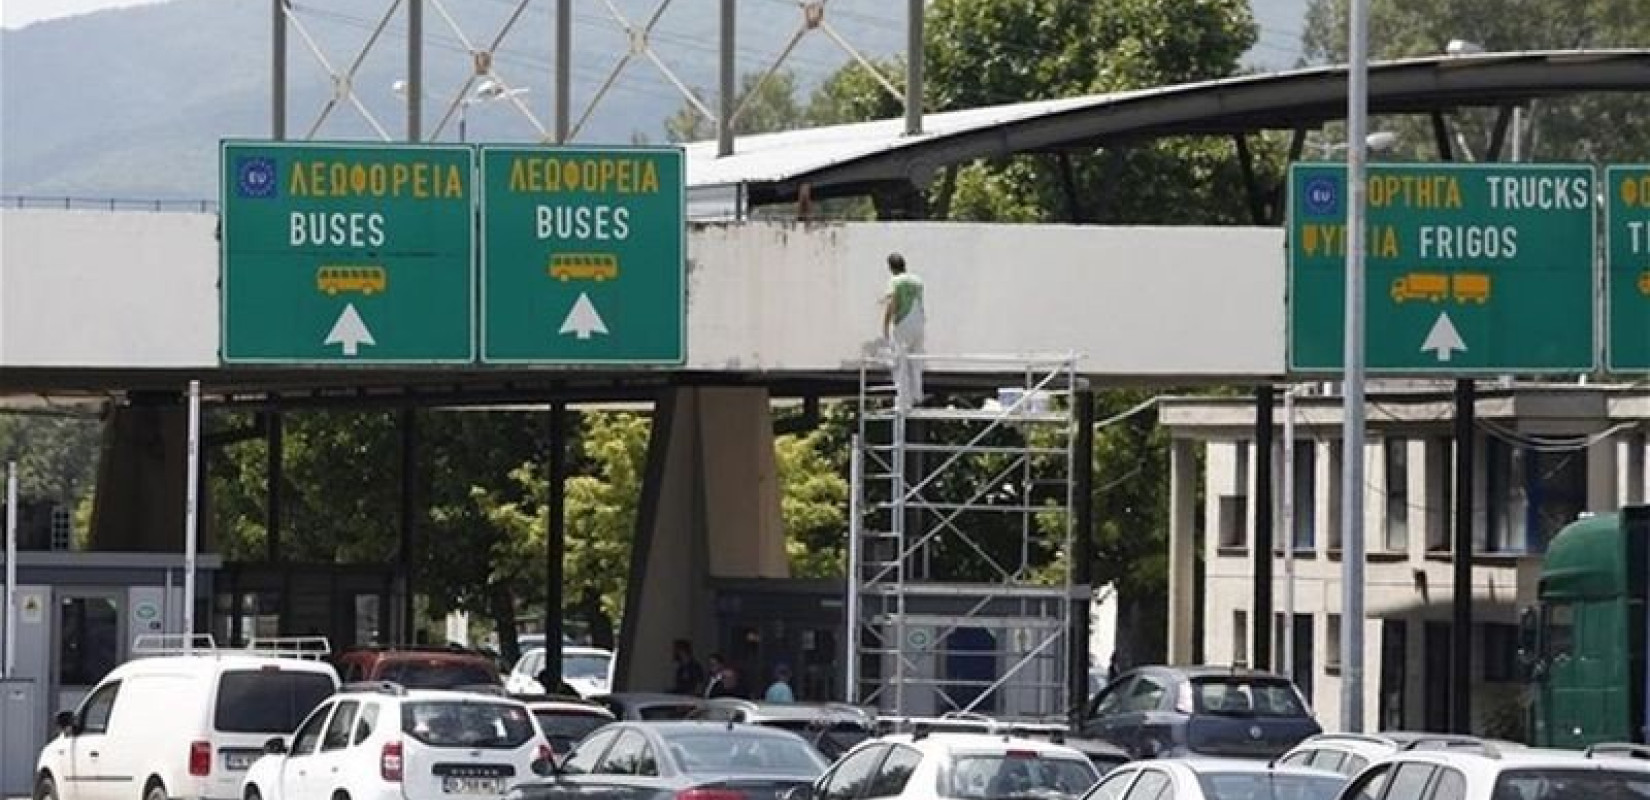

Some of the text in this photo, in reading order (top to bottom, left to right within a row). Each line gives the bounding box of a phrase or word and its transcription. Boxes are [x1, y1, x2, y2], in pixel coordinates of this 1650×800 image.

[249, 171, 267, 184] EU
[289, 161, 463, 198] ΛΕΩΦΟΡΕΙΑ
[509, 158, 660, 194] ΛΕΩΦΟΡΕΙΑ
[1486, 176, 1589, 210] TRUCKS
[1312, 189, 1332, 202] EU
[290, 212, 385, 247] BUSES
[536, 205, 630, 240] BUSES
[1420, 225, 1518, 258] FRIGOS
